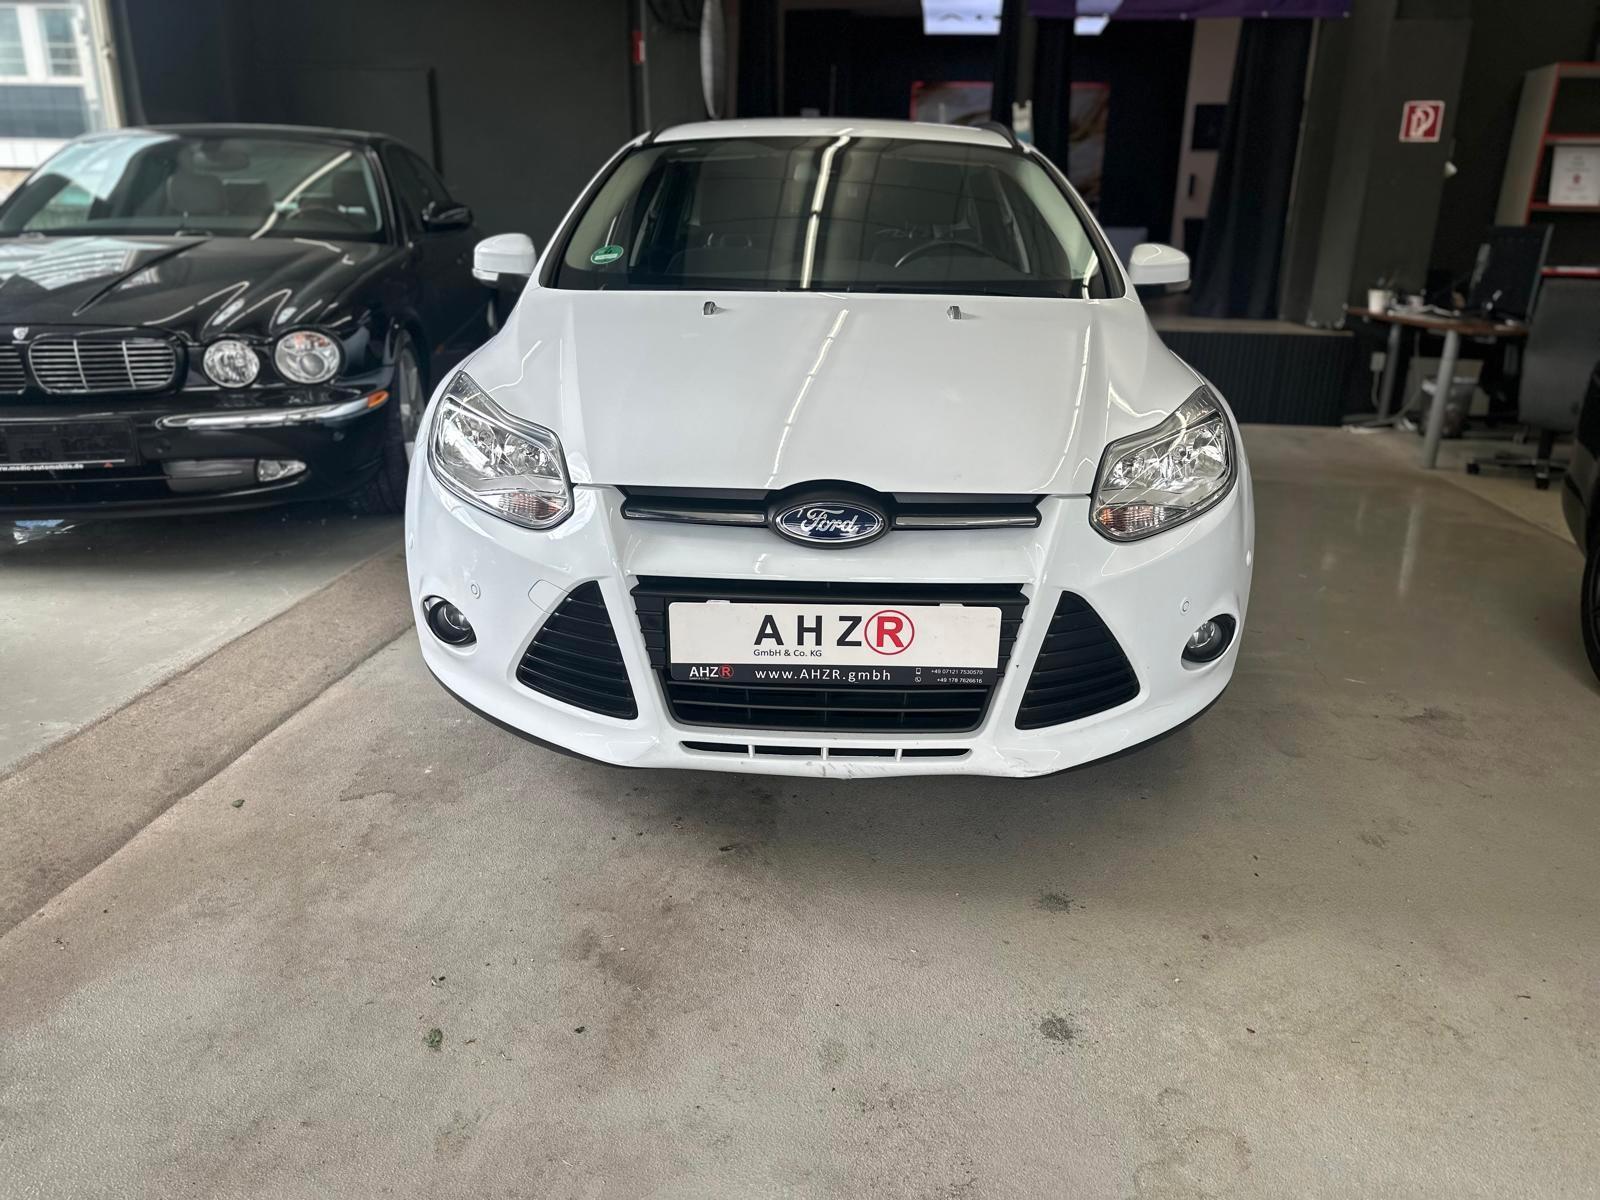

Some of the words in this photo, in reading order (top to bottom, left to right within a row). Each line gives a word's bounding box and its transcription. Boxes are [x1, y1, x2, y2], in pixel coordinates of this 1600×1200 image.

[800, 508, 860, 533] Ford
[753, 611, 912, 651] AHZR
[753, 649, 782, 657] GmbH
[784, 649, 792, 657] &
[793, 649, 808, 657] Co.
[689, 666, 734, 678] AHZR
[755, 669, 891, 682] www.AHZR.gmbh
